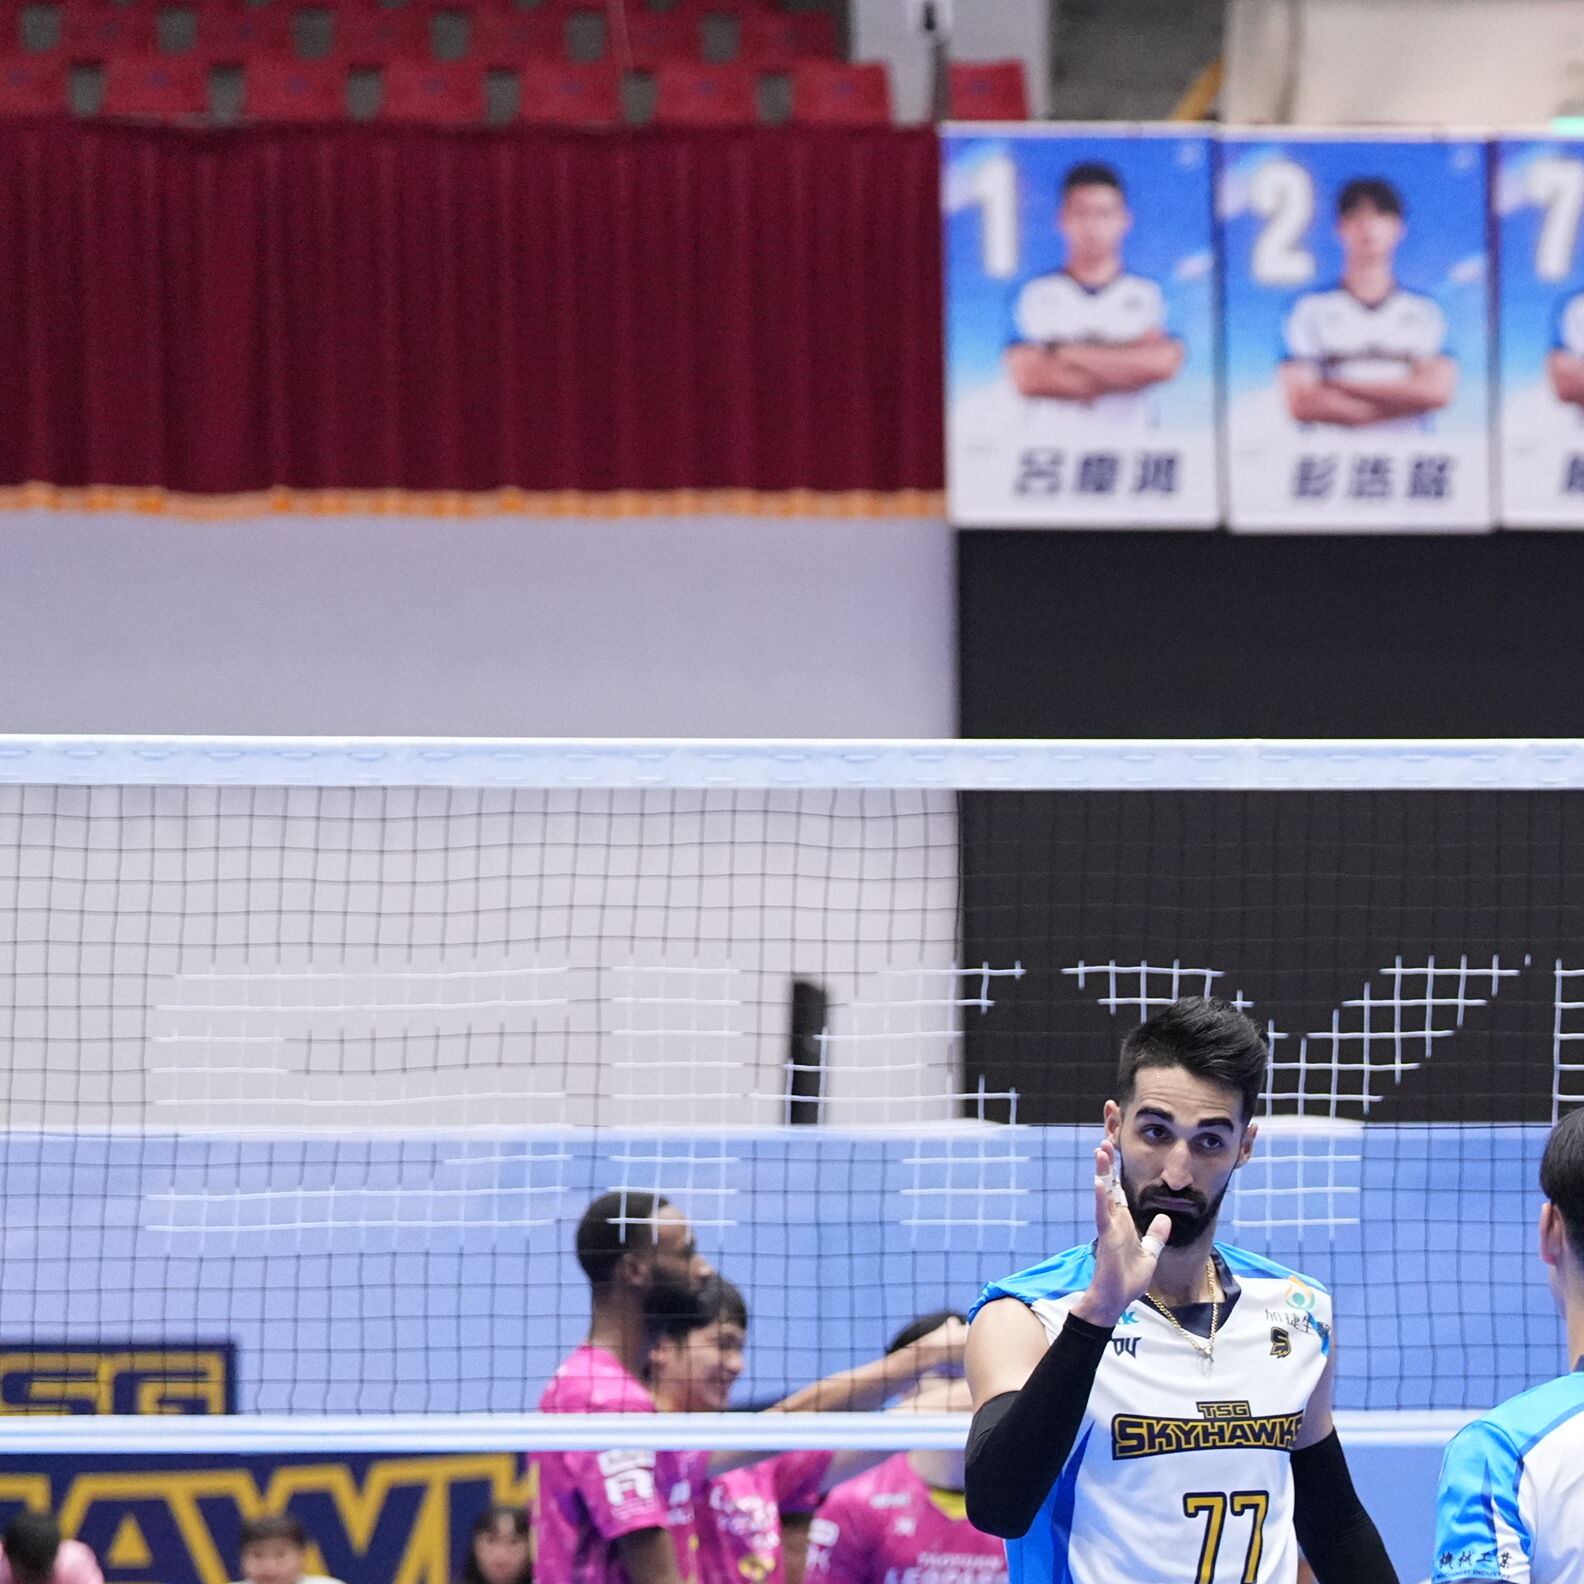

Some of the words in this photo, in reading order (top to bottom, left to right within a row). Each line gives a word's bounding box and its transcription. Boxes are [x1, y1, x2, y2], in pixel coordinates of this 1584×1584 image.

[972, 158, 1020, 280] 1
[1248, 160, 1317, 287] 2
[1198, 1402, 1250, 1418] TSG
